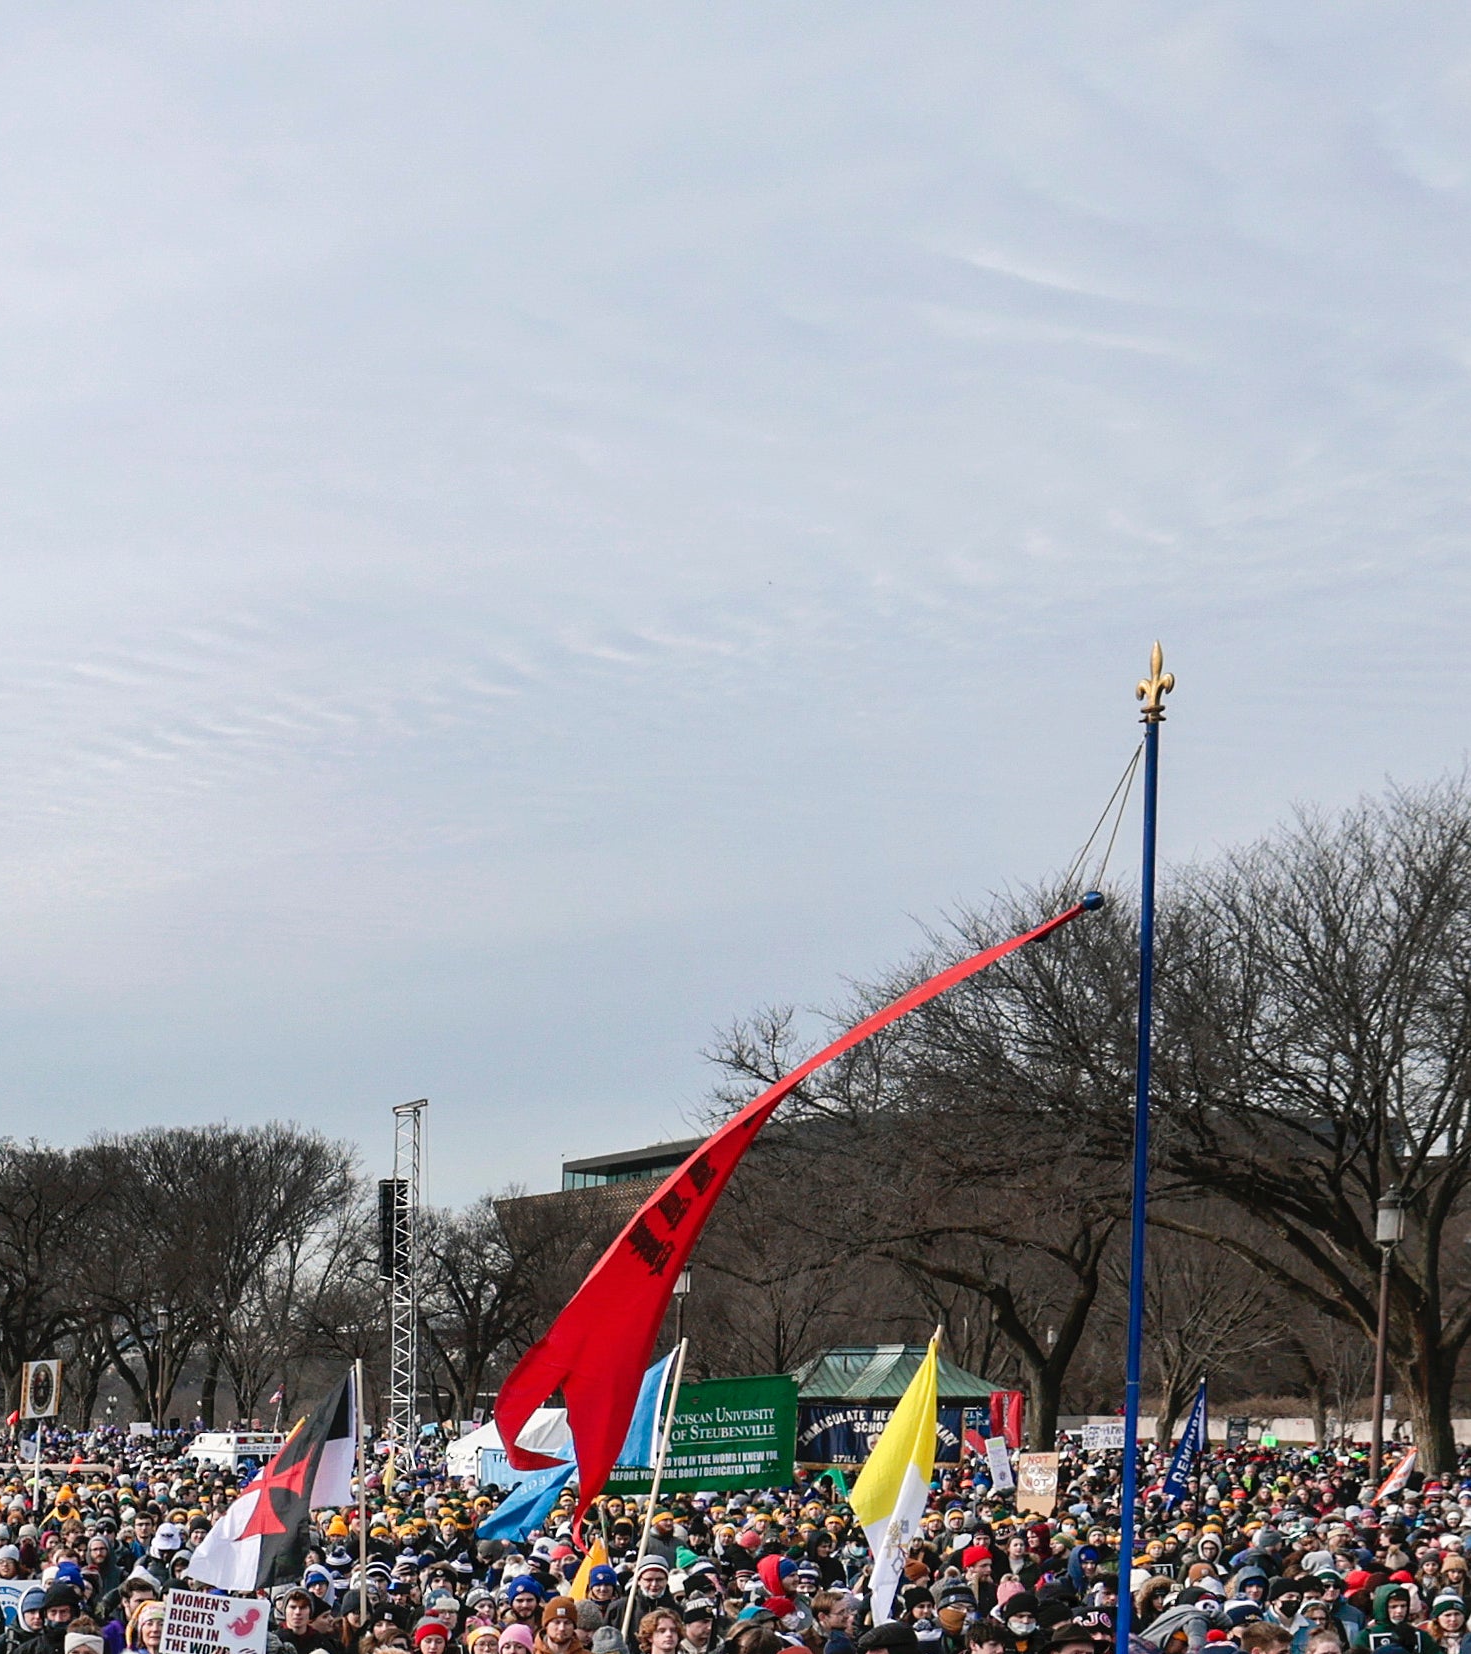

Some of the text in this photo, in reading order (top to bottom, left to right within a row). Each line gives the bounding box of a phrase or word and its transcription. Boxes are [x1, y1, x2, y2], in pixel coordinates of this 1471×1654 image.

[716, 1406, 776, 1423] UNIVERSITY
[689, 1423, 776, 1440] STEUBENVILLE
[800, 1409, 866, 1446] IMMACULATE
[672, 1456, 687, 1467] YOU
[697, 1455, 709, 1465] THE
[711, 1454, 736, 1465] WOMB
[742, 1452, 763, 1463] KNEW
[1027, 1455, 1050, 1464] NOT
[609, 1469, 639, 1481] BEFORE
[680, 1467, 698, 1478] BORN
[703, 1465, 747, 1477] DEDICATED
[172, 1591, 231, 1613] WOMEN'S
[169, 1609, 215, 1626] RIGHTS
[167, 1624, 220, 1642] BEGIN IN
[165, 1638, 187, 1653] THE
